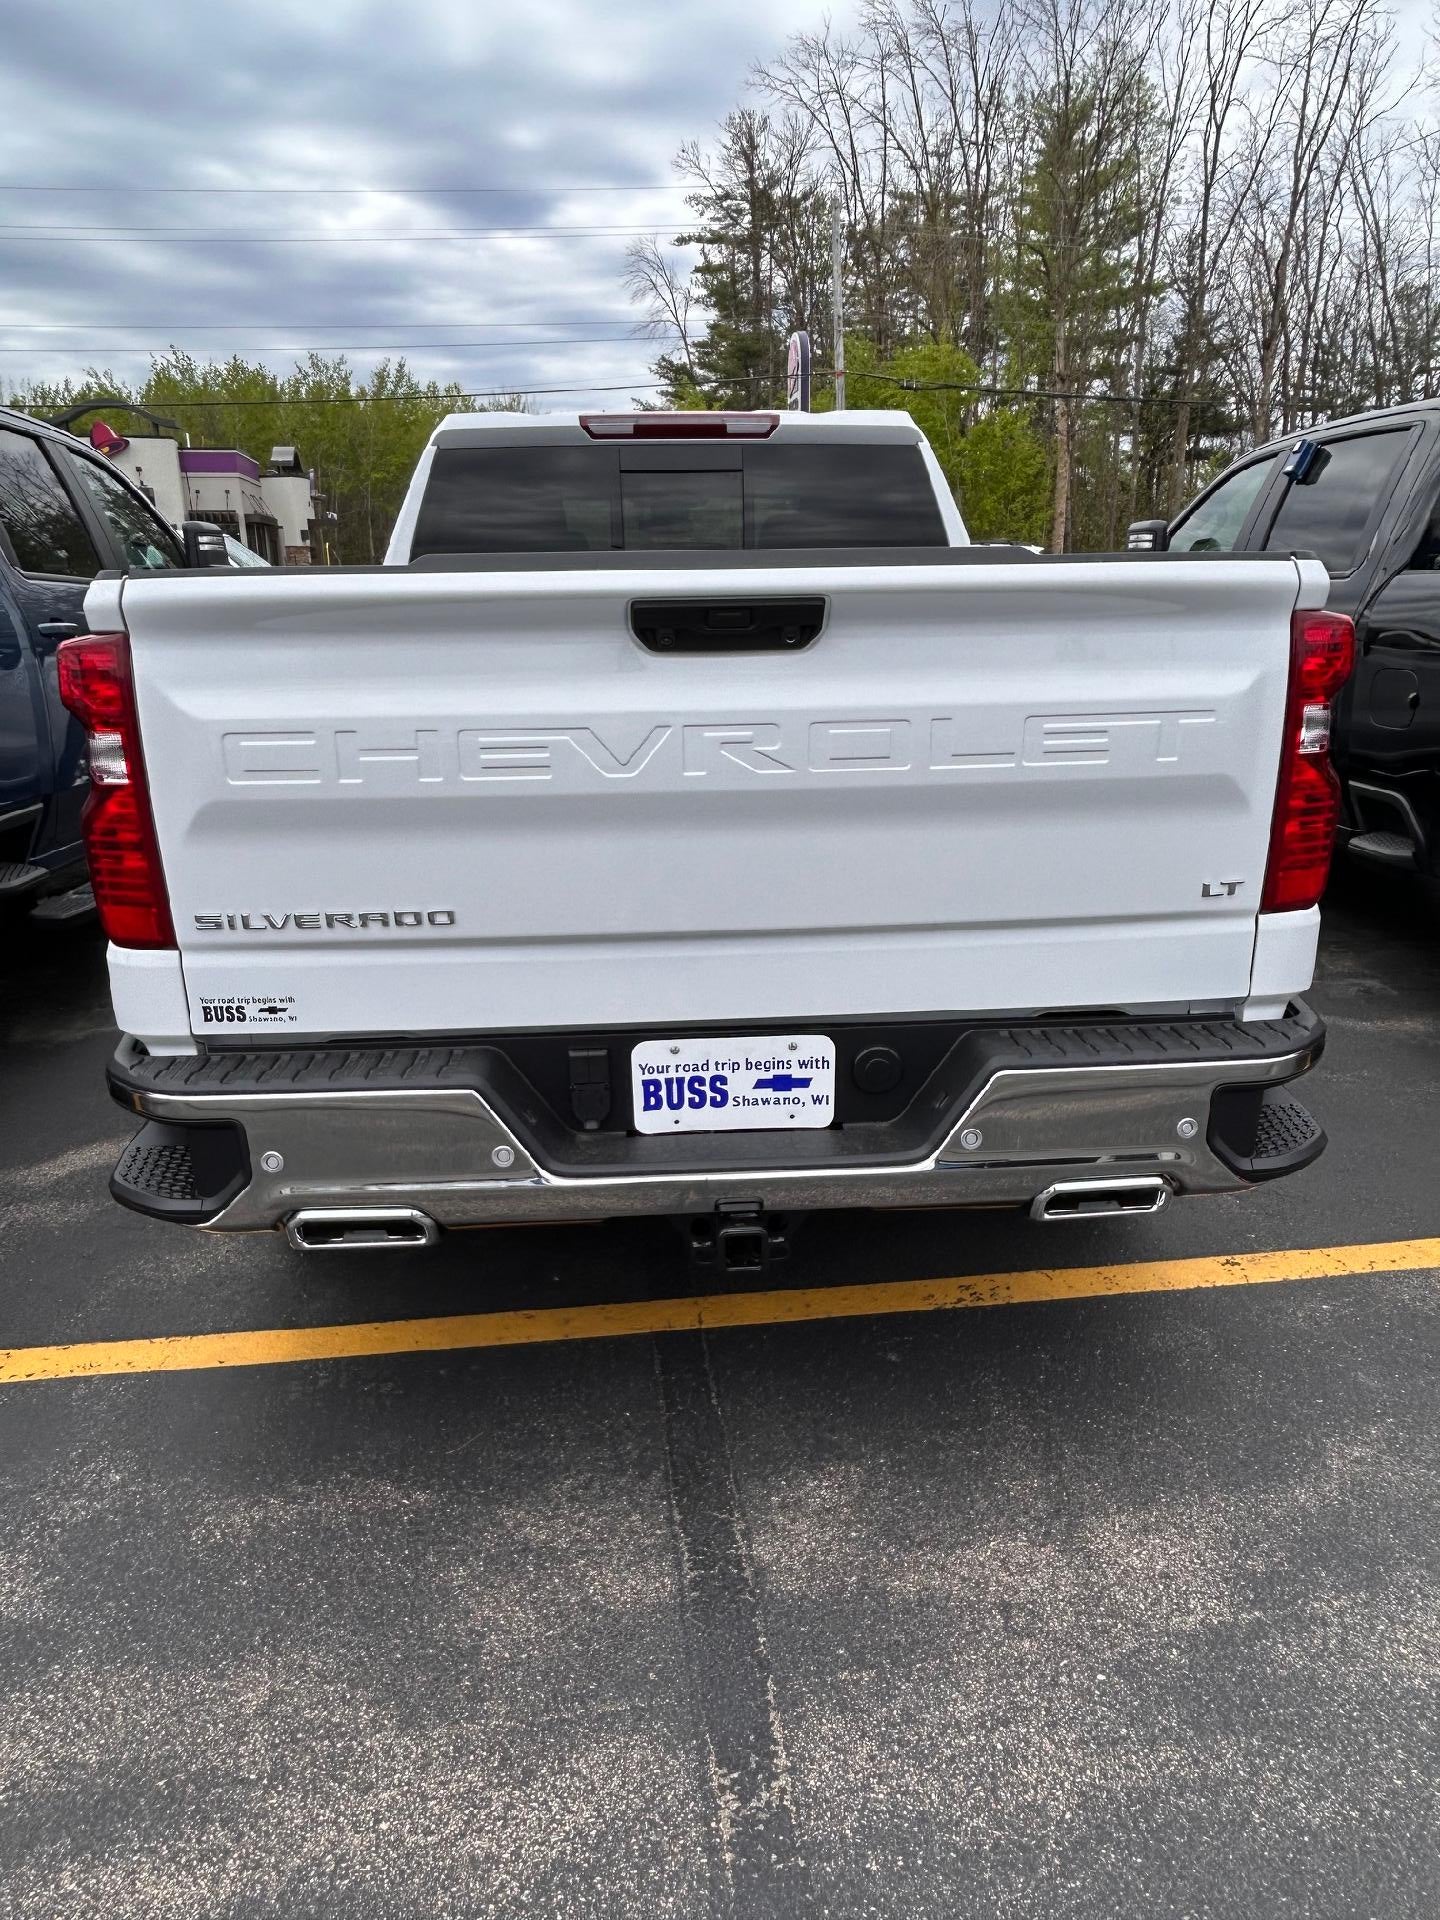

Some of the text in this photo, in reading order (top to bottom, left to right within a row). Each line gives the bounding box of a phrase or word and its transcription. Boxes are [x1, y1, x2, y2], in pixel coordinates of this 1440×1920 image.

[223, 709, 1219, 785] CHEVROLET
[1202, 878, 1246, 898] LT
[194, 909, 456, 931] SILVERADO
[199, 997, 216, 1005] Your
[237, 996, 251, 1005] trip
[252, 996, 277, 1005] begins
[278, 996, 296, 1004] with
[202, 1005, 247, 1023] BUSS
[639, 1056, 830, 1076] Your road trip begins with
[641, 1074, 729, 1112] BUSS
[732, 1094, 830, 1107] Shawano, WI
